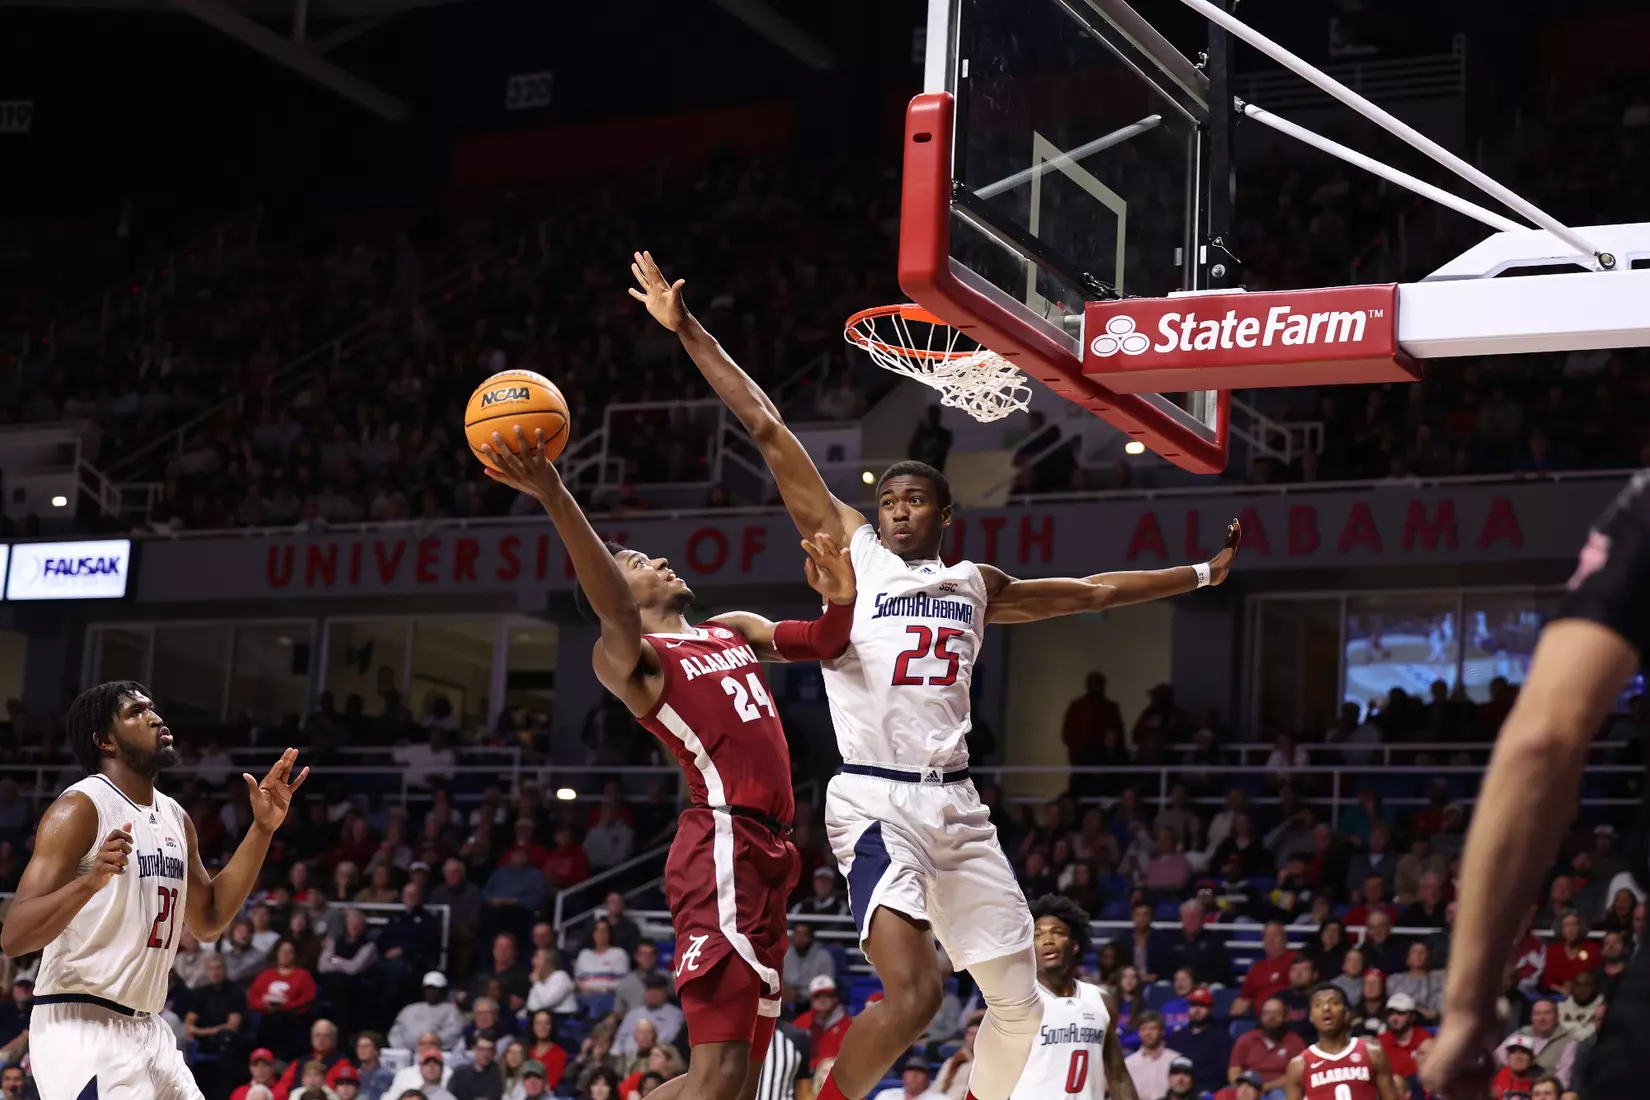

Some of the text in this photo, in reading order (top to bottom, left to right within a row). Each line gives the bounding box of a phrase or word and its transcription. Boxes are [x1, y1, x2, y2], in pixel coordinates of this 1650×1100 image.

[481, 387, 530, 408] NCAA
[687, 527, 766, 574] OF
[1126, 496, 1524, 561] ALABAMA
[44, 557, 120, 576] FAUSAK
[680, 644, 759, 681] ALABAM
[891, 625, 965, 686] 25
[721, 672, 775, 723] 24
[1065, 1049, 1089, 1094] 0
[1310, 1066, 1370, 1089] ALABAMA
